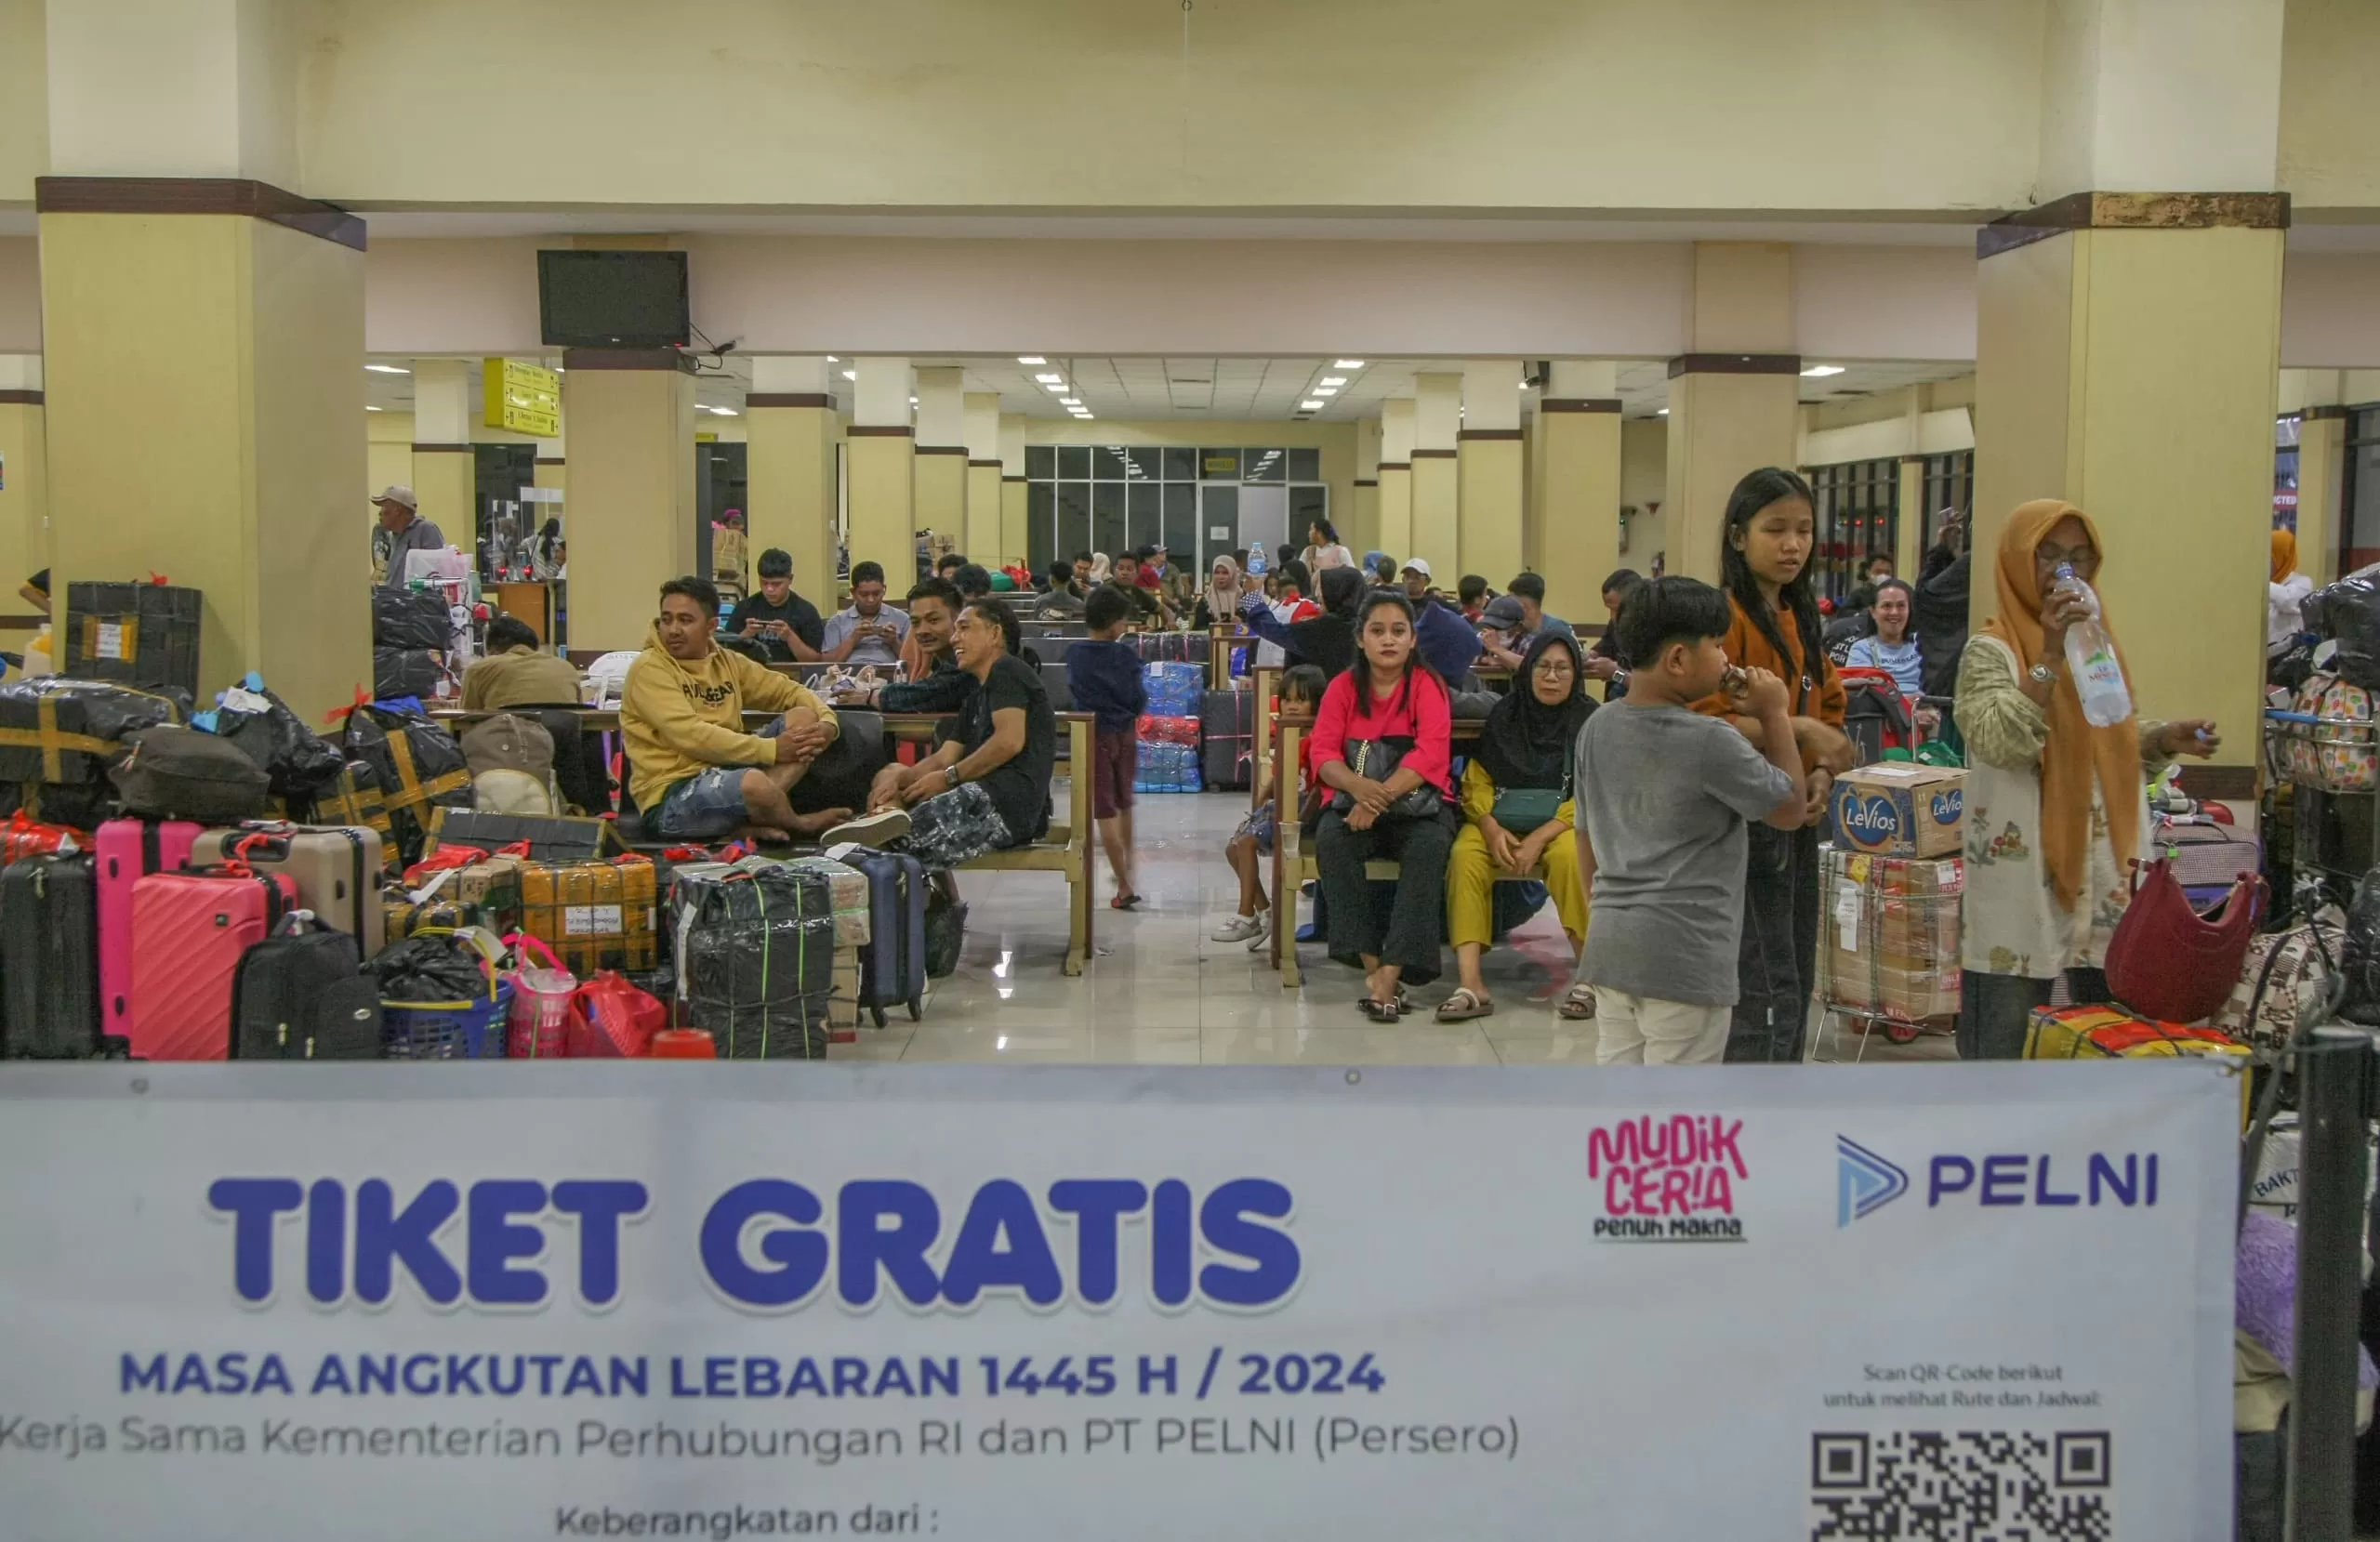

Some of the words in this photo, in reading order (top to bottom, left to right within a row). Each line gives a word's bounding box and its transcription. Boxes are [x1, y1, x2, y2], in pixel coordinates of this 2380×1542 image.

[1934, 791, 1964, 816] LeVio
[1928, 1153, 2159, 1208] PELNI
[208, 1178, 649, 1305] TIKET
[698, 1178, 1302, 1307] GRATIS
[120, 1352, 294, 1395] MASA
[309, 1353, 649, 1398] ANGKUTAN
[669, 1356, 960, 1399] LEBARAN
[978, 1355, 1117, 1397] 1445
[1137, 1355, 1178, 1396] H
[1196, 1347, 1224, 1401] /
[1238, 1352, 1386, 1395] 2024
[1863, 1363, 1906, 1381] Scan
[1998, 1363, 2063, 1381] berikut
[1823, 1389, 1877, 1407] untuk
[1881, 1389, 1948, 1407] melihat
[1951, 1389, 1994, 1407] Rute
[1998, 1389, 2033, 1407] dan
[0, 1415, 107, 1460] Kerja
[120, 1416, 246, 1454] Sama
[262, 1418, 562, 1456] Kementerian
[576, 1418, 904, 1467] Perhubungan
[919, 1419, 962, 1455] RI
[977, 1417, 1067, 1456] dan
[1084, 1417, 1143, 1455] PT
[1156, 1417, 1296, 1455] PELNI
[1315, 1415, 1520, 1463] (Persero)
[555, 1504, 839, 1541] Keberangkatan
[849, 1503, 919, 1535] dari
